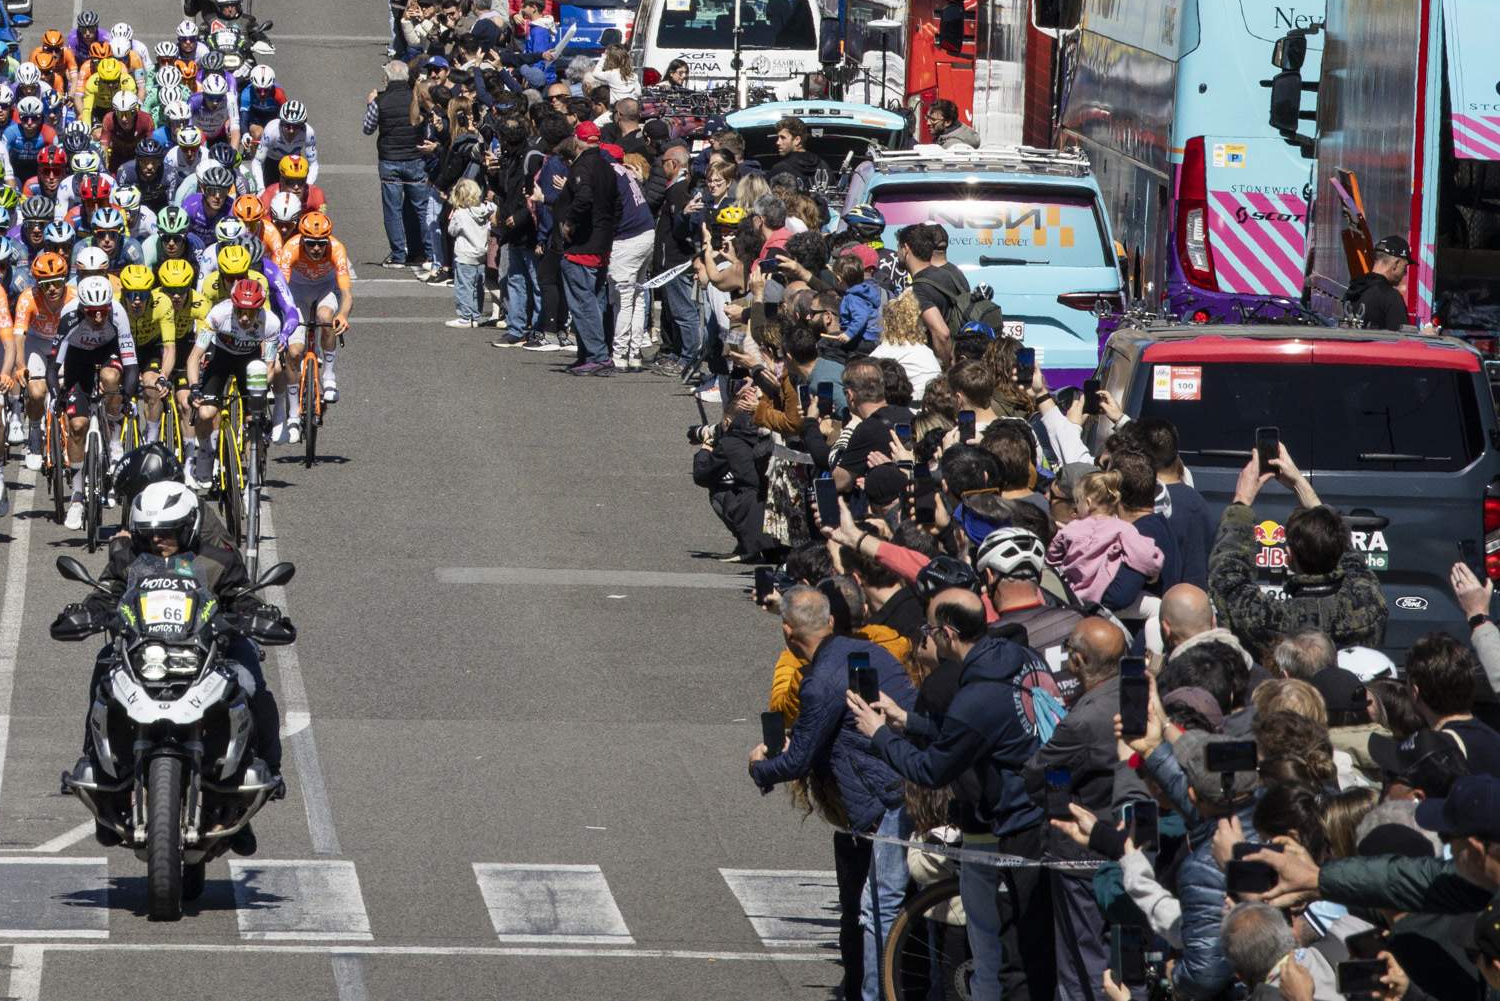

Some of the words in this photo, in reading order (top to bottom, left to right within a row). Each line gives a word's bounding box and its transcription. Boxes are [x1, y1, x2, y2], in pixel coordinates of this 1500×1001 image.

[1230, 184, 1298, 197] STONEWEG
[949, 237, 973, 247] ever
[975, 237, 994, 249] say
[997, 237, 1030, 248] never
[1351, 530, 1389, 552] RA
[139, 577, 179, 590] MOTOS
[181, 578, 197, 590] TV
[163, 606, 182, 622] 66
[148, 624, 173, 633] MOTOS
[174, 624, 183, 633] TV
